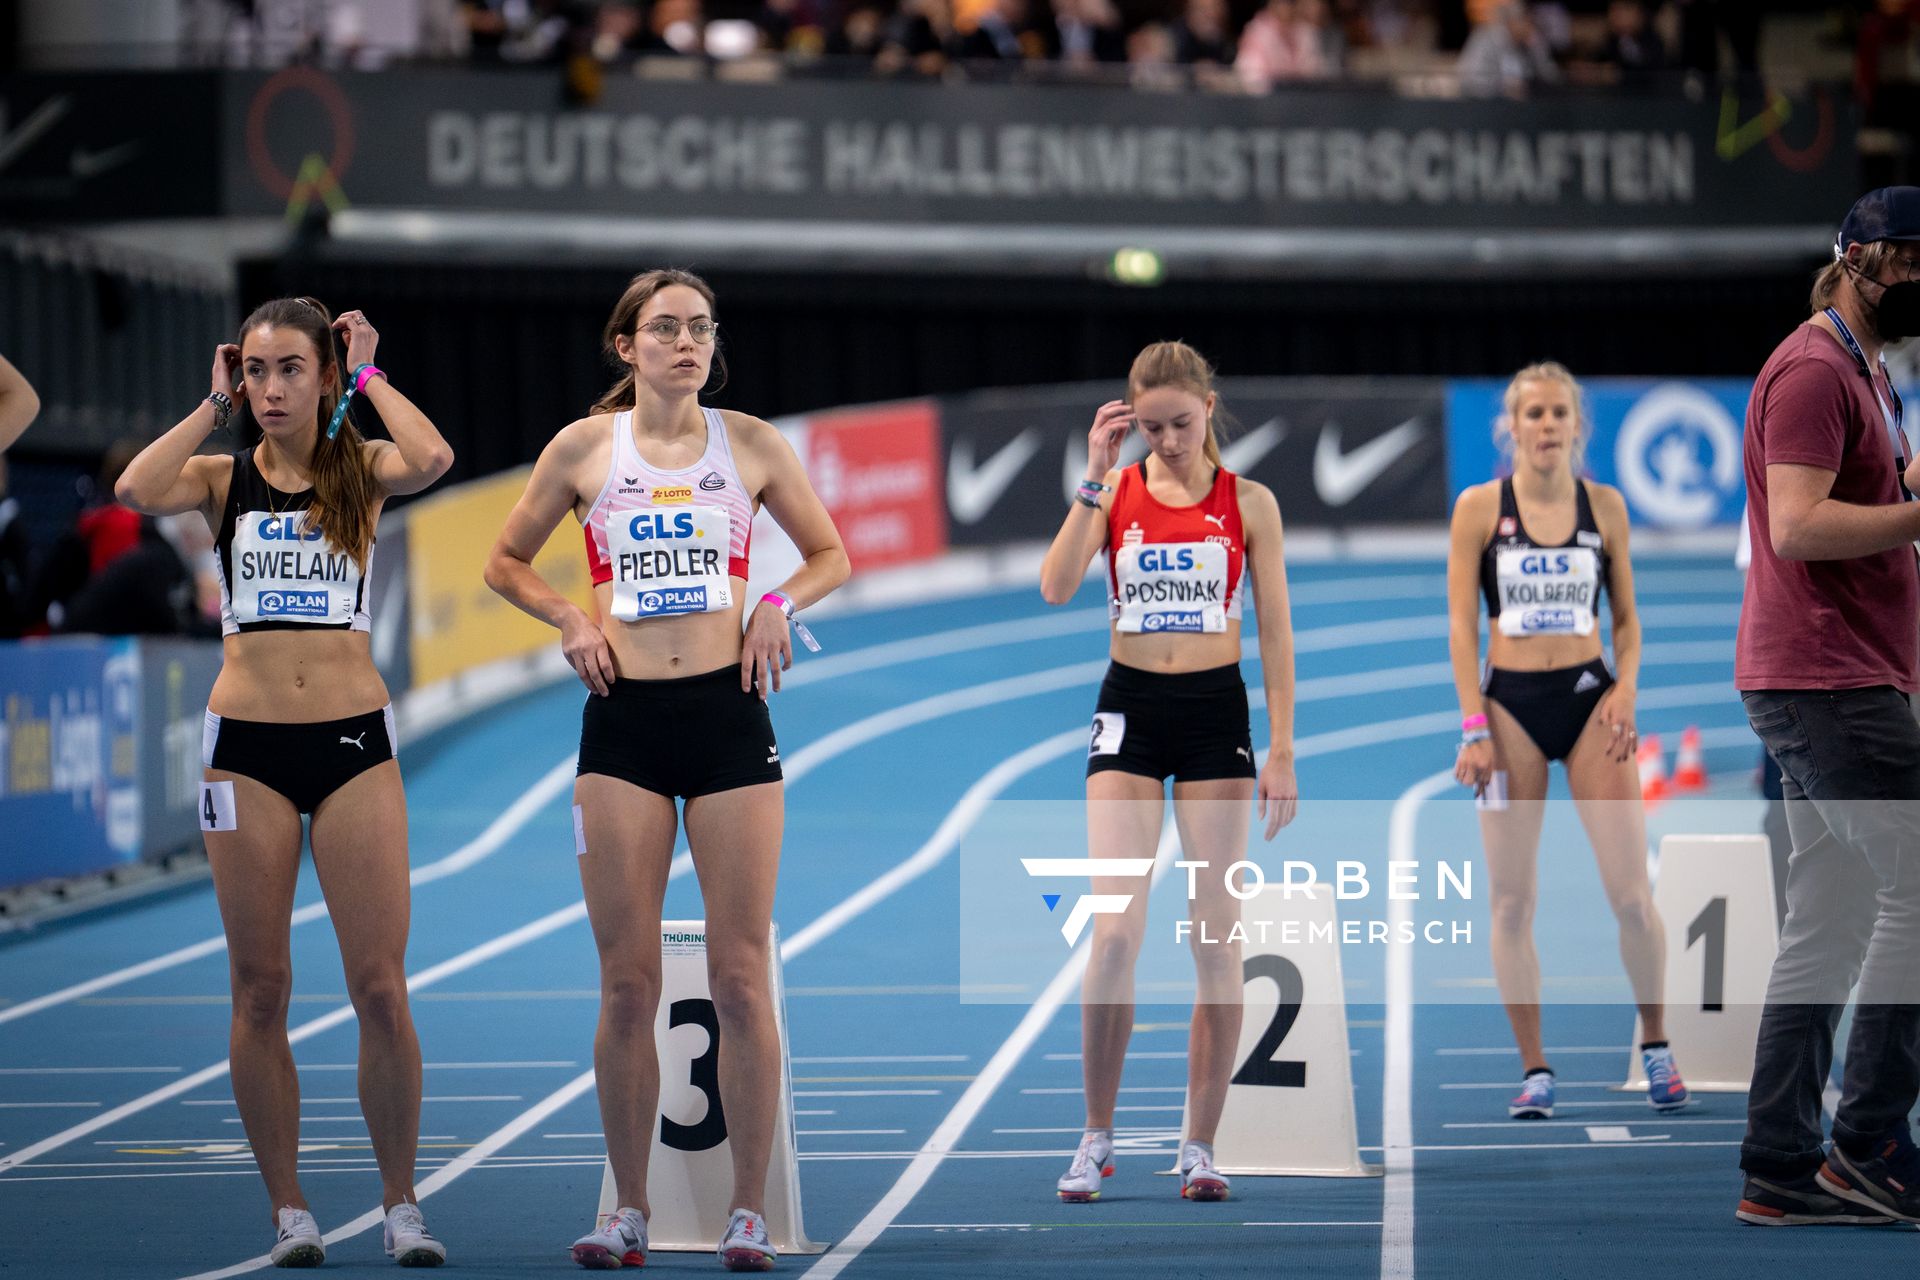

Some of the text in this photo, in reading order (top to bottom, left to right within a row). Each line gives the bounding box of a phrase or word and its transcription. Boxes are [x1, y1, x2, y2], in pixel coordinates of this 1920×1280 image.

[428, 112, 1695, 202] DEUTSCHE HALLENMEISTERSCHAFTEN
[618, 486, 645, 494] erima
[664, 489, 692, 498] LOTTO
[241, 551, 348, 582] SWELAM
[619, 548, 720, 582] FIEDLER
[286, 595, 326, 607] PLAN
[665, 591, 704, 604] PLAN
[1125, 579, 1220, 604] POSNIAK
[1506, 582, 1589, 605] KOLBERG
[1166, 614, 1201, 626] PLAN
[1090, 718, 1104, 752] 2
[204, 788, 217, 828] 4
[1685, 896, 1728, 1012] 1
[1232, 953, 1307, 1088] 2
[660, 998, 728, 1152] 3
